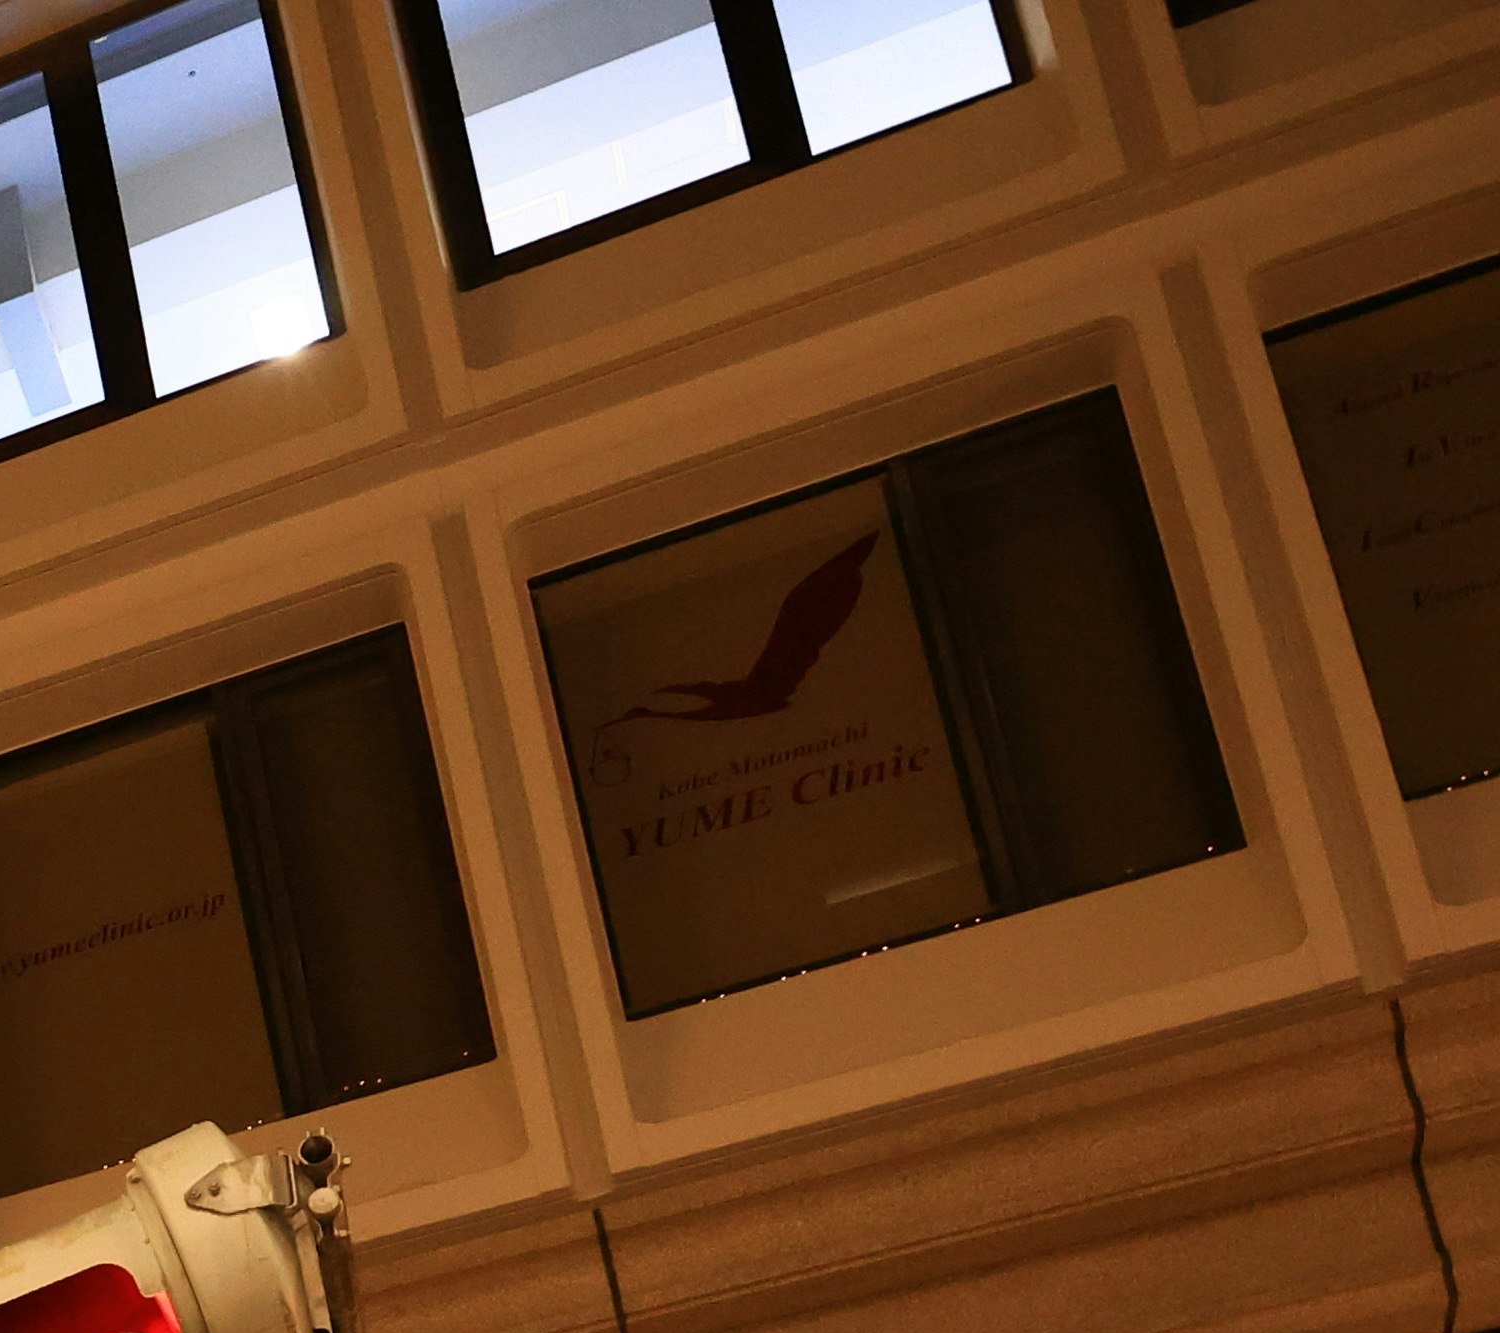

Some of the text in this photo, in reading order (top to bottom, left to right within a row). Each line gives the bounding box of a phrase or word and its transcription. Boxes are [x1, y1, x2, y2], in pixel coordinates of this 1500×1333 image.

[621, 744, 932, 860] YUME Clinic
[659, 720, 869, 801] Kobe Motomachi
